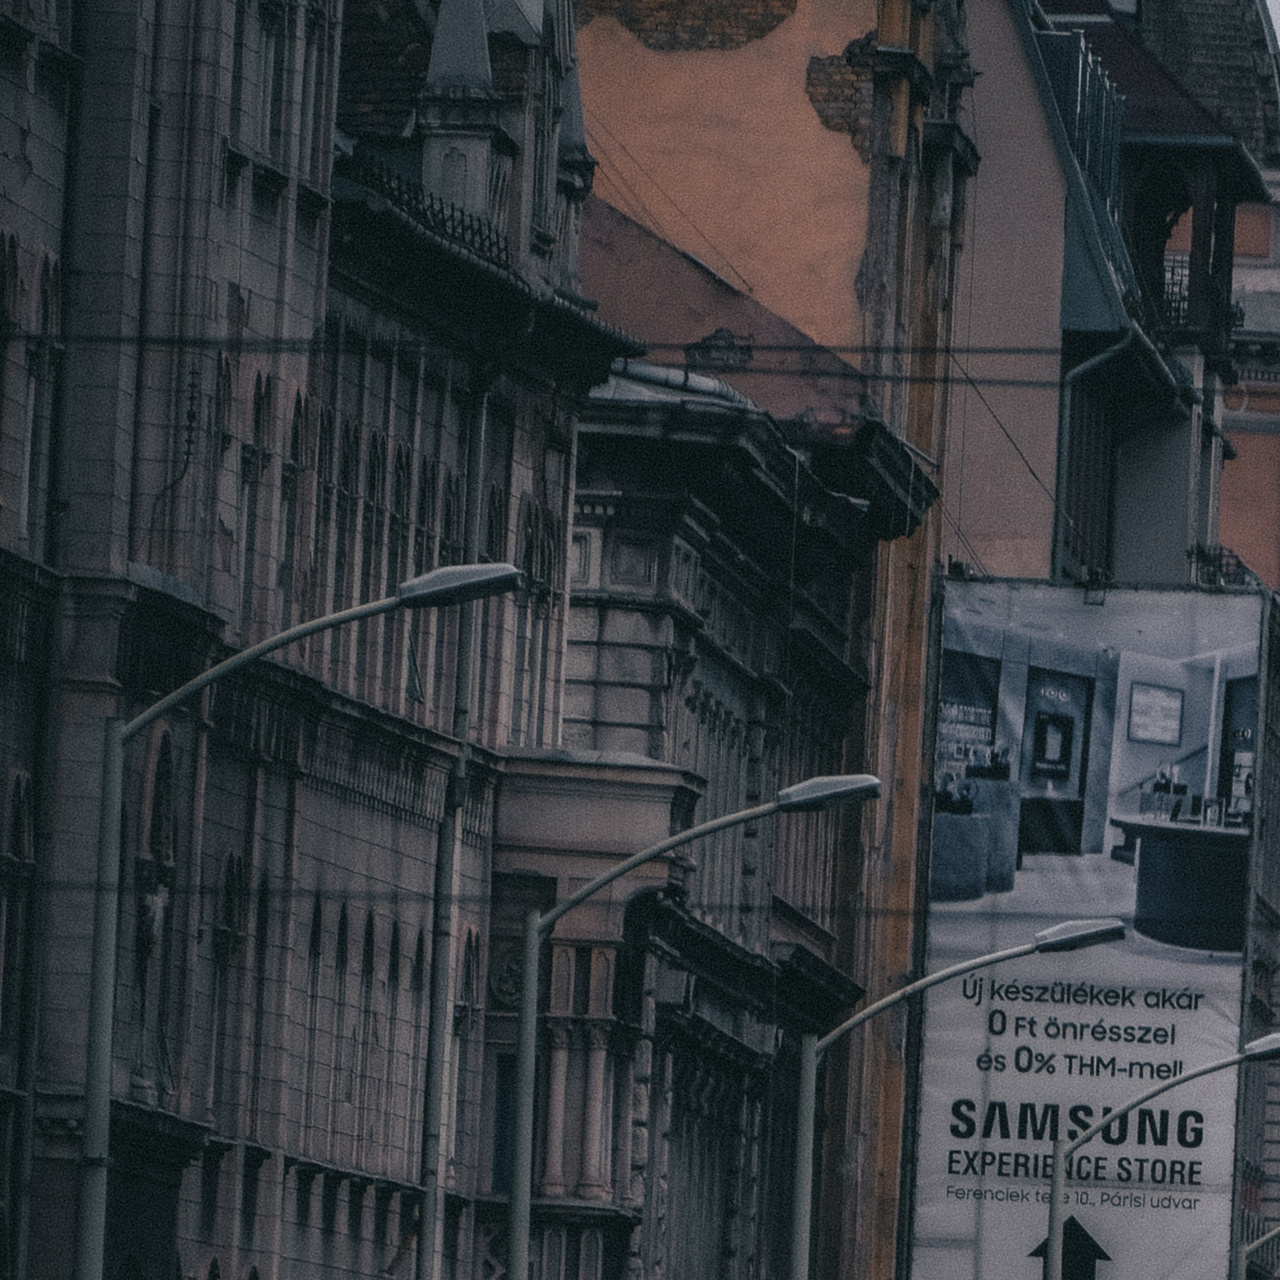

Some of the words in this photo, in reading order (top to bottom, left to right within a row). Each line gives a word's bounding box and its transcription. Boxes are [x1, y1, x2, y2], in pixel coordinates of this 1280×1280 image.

[962, 974, 984, 1006] Új
[990, 980, 1136, 1007] készülékek
[1143, 986, 1204, 1010] akár
[989, 1009, 1007, 1035] 0
[1015, 1016, 1036, 1037] Ft
[1044, 1016, 1176, 1045] önrésszel
[976, 1048, 1006, 1073] és
[1015, 1046, 1056, 1075] 0%
[949, 1098, 1205, 1148] SAMSUNG
[1116, 1156, 1203, 1186] STORE
[946, 1185, 1030, 1203] Ferenciek
[1034, 1189, 1070, 1205] tee
[1150, 1192, 1201, 1210] udvar
